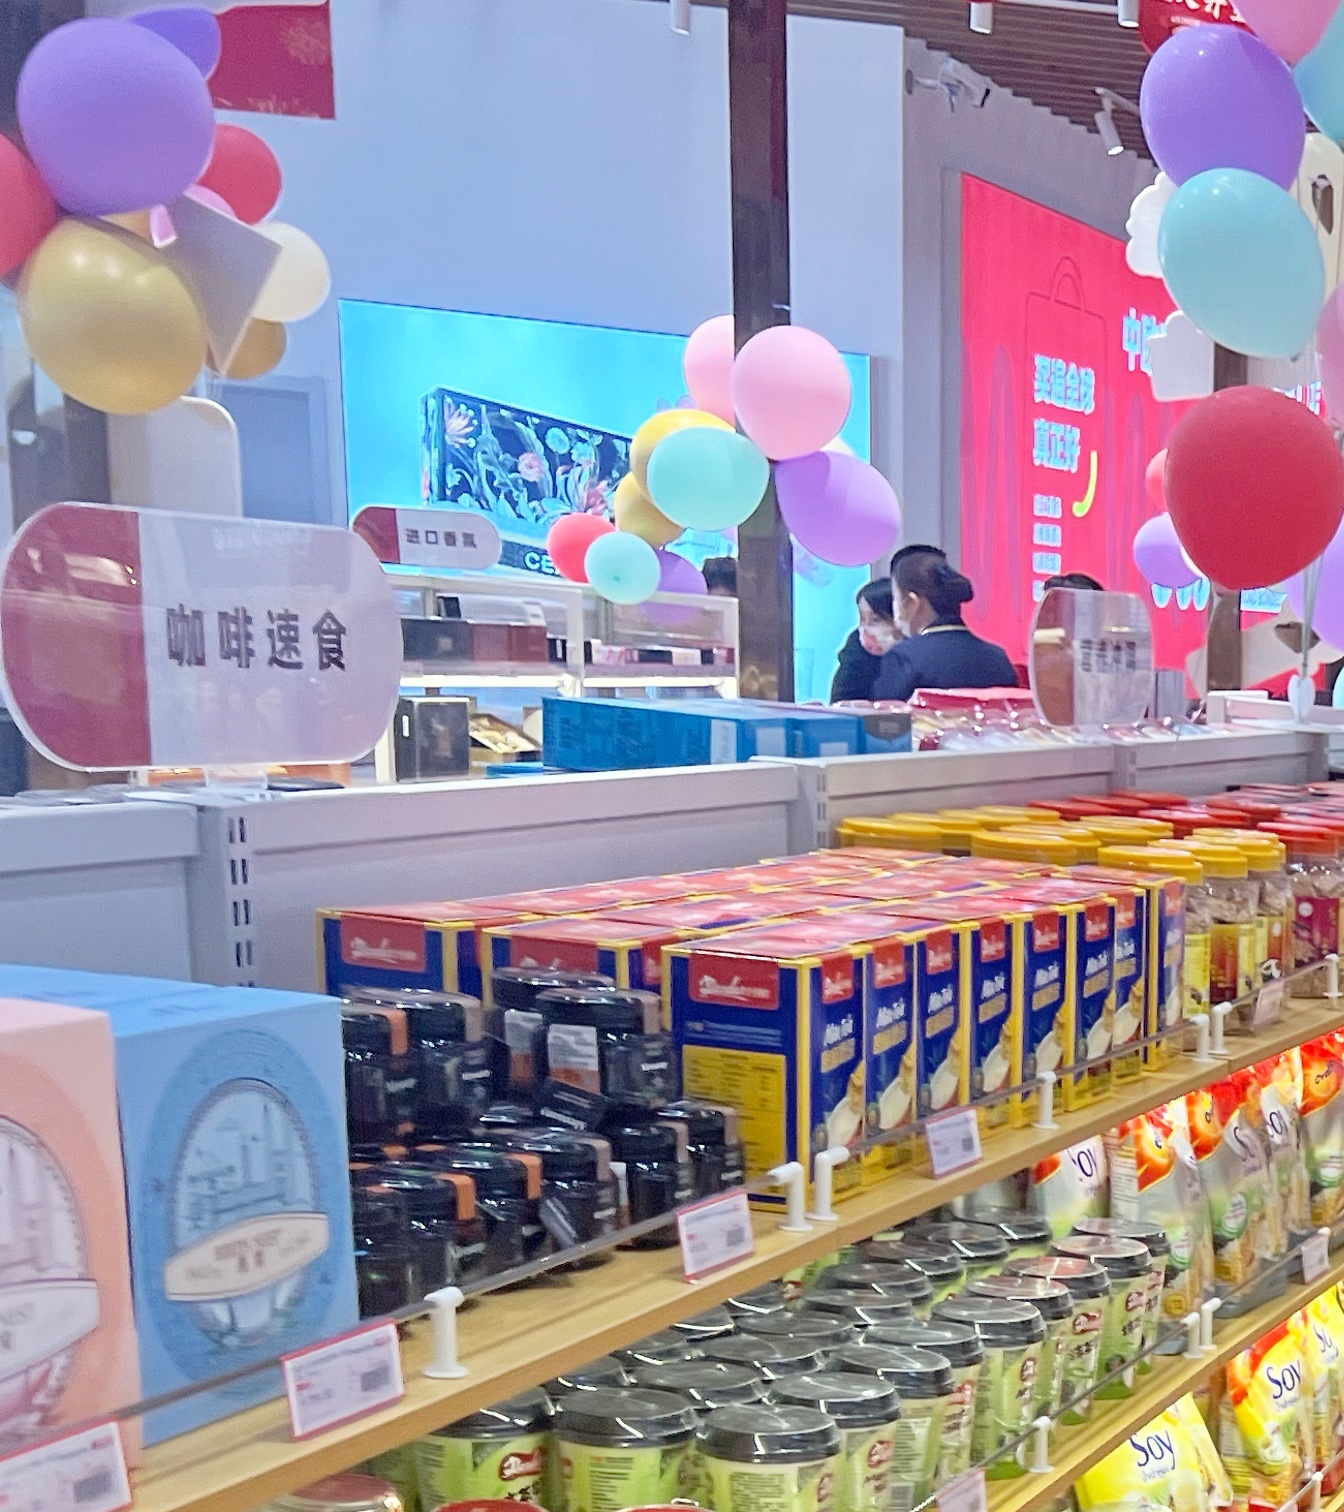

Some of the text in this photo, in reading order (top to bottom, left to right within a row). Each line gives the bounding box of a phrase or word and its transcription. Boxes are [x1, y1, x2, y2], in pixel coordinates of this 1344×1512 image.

[523, 550, 560, 577] CE
[166, 603, 348, 672] 咖啡速食
[1129, 1429, 1177, 1471] Soy
